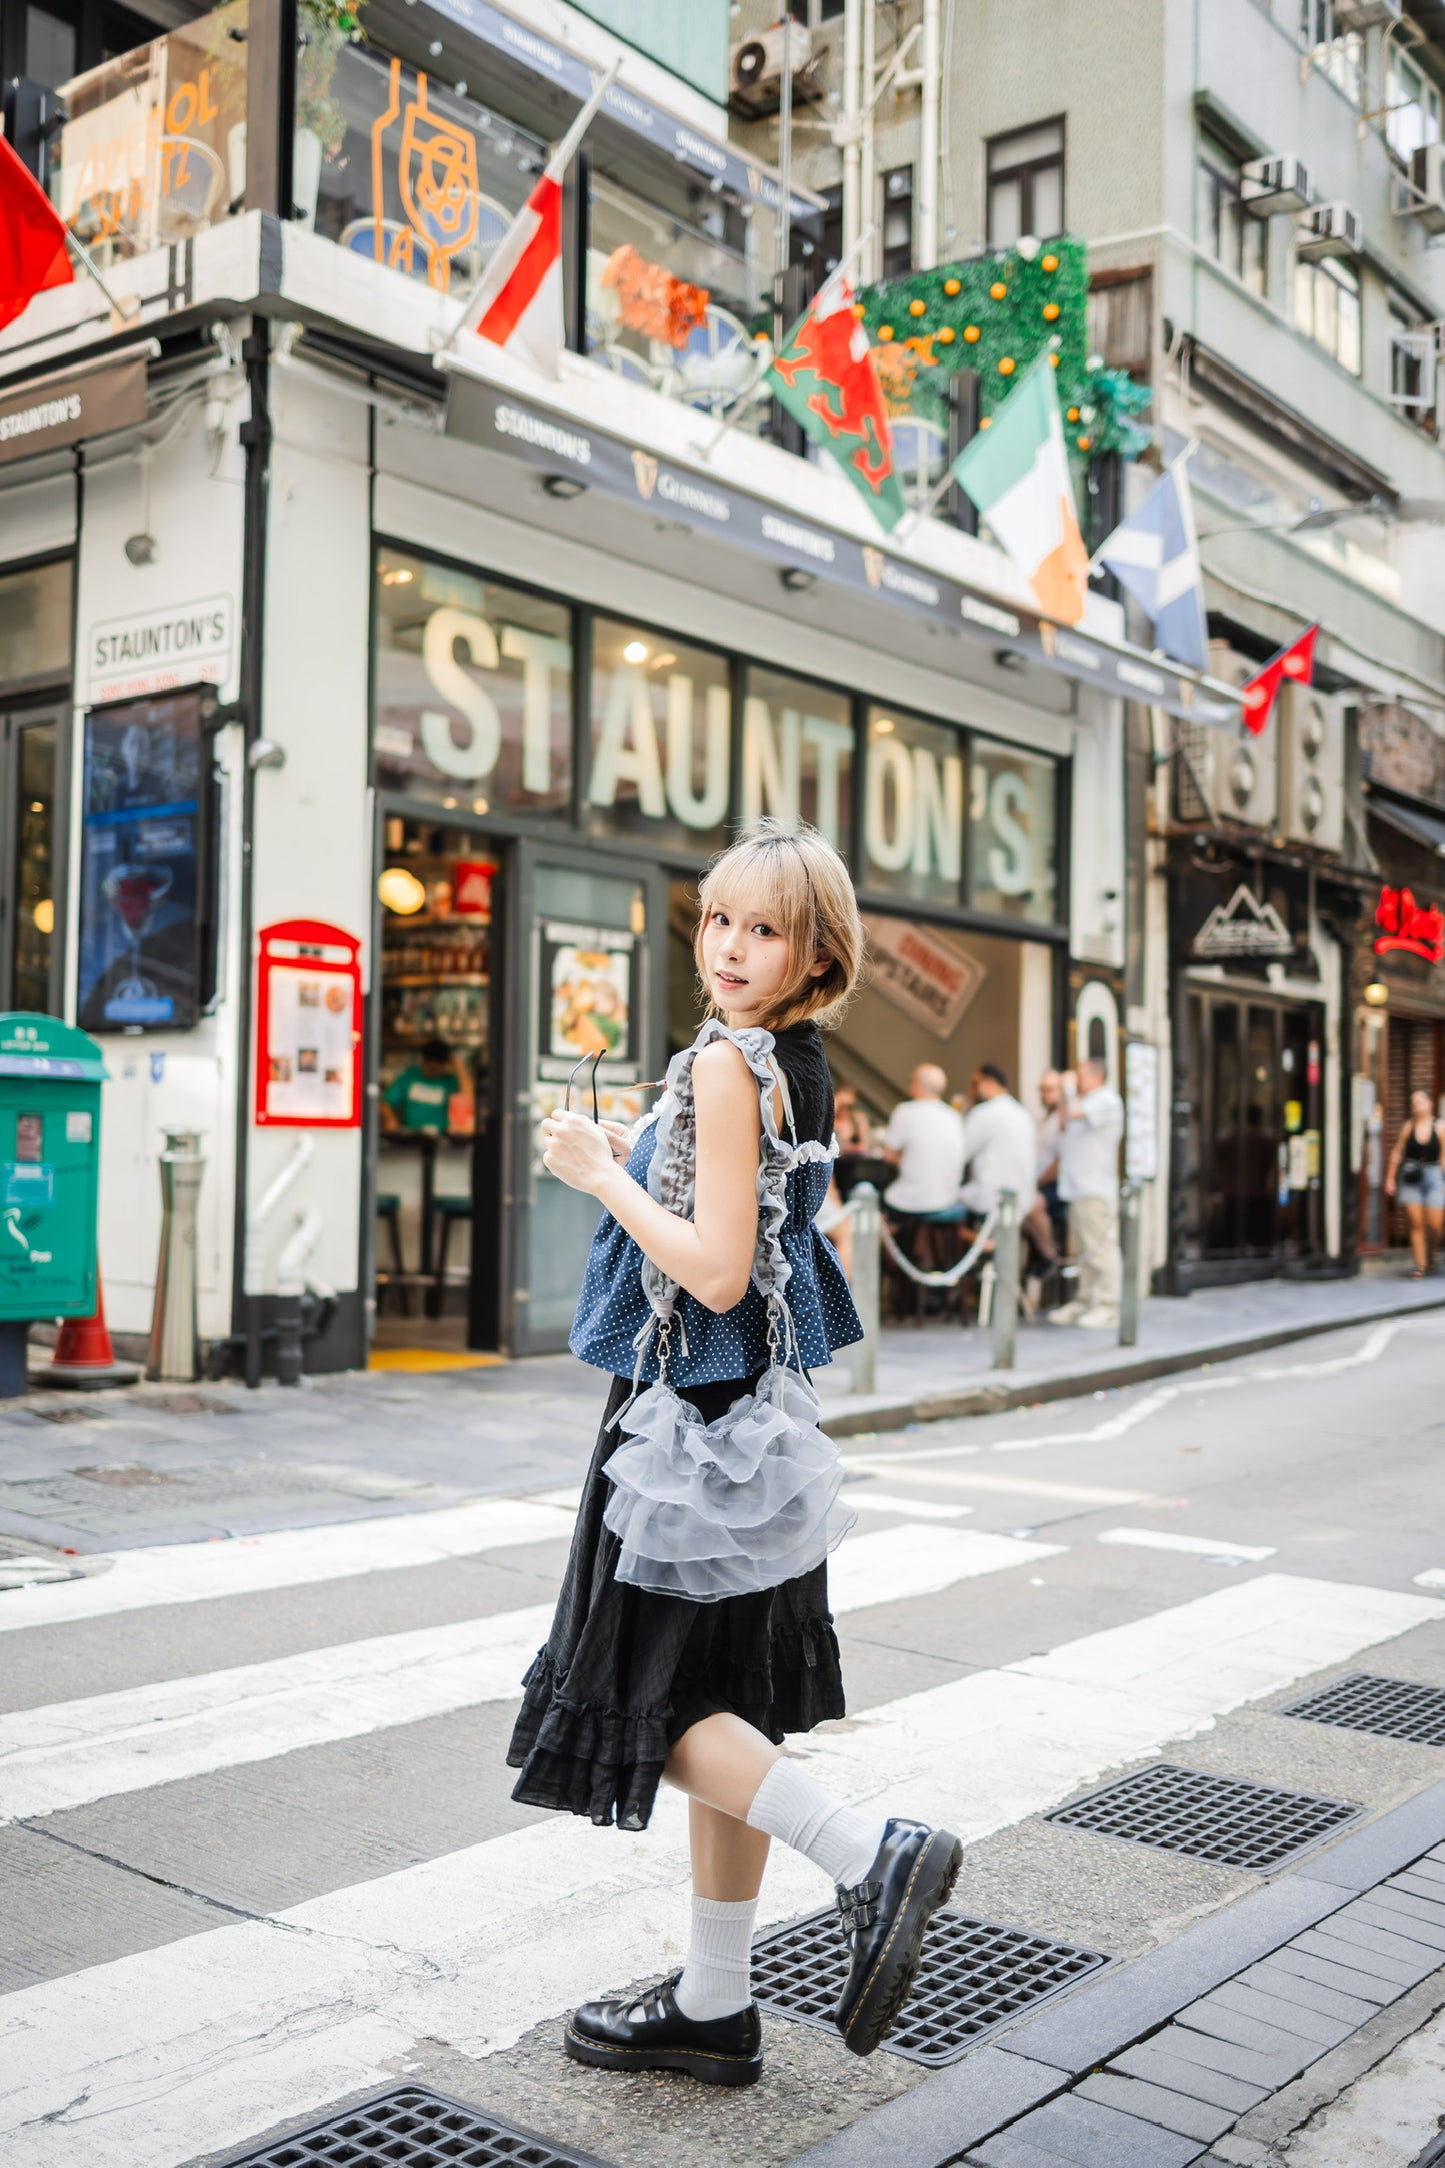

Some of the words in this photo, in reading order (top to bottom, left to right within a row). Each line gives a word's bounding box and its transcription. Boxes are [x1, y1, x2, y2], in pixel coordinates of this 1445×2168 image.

[0, 393, 81, 441] STAUNTON'S
[494, 404, 591, 465] STAUNTON'S
[95, 610, 225, 667] STAUNTON'S
[420, 606, 1033, 897] STAUNTON'S
